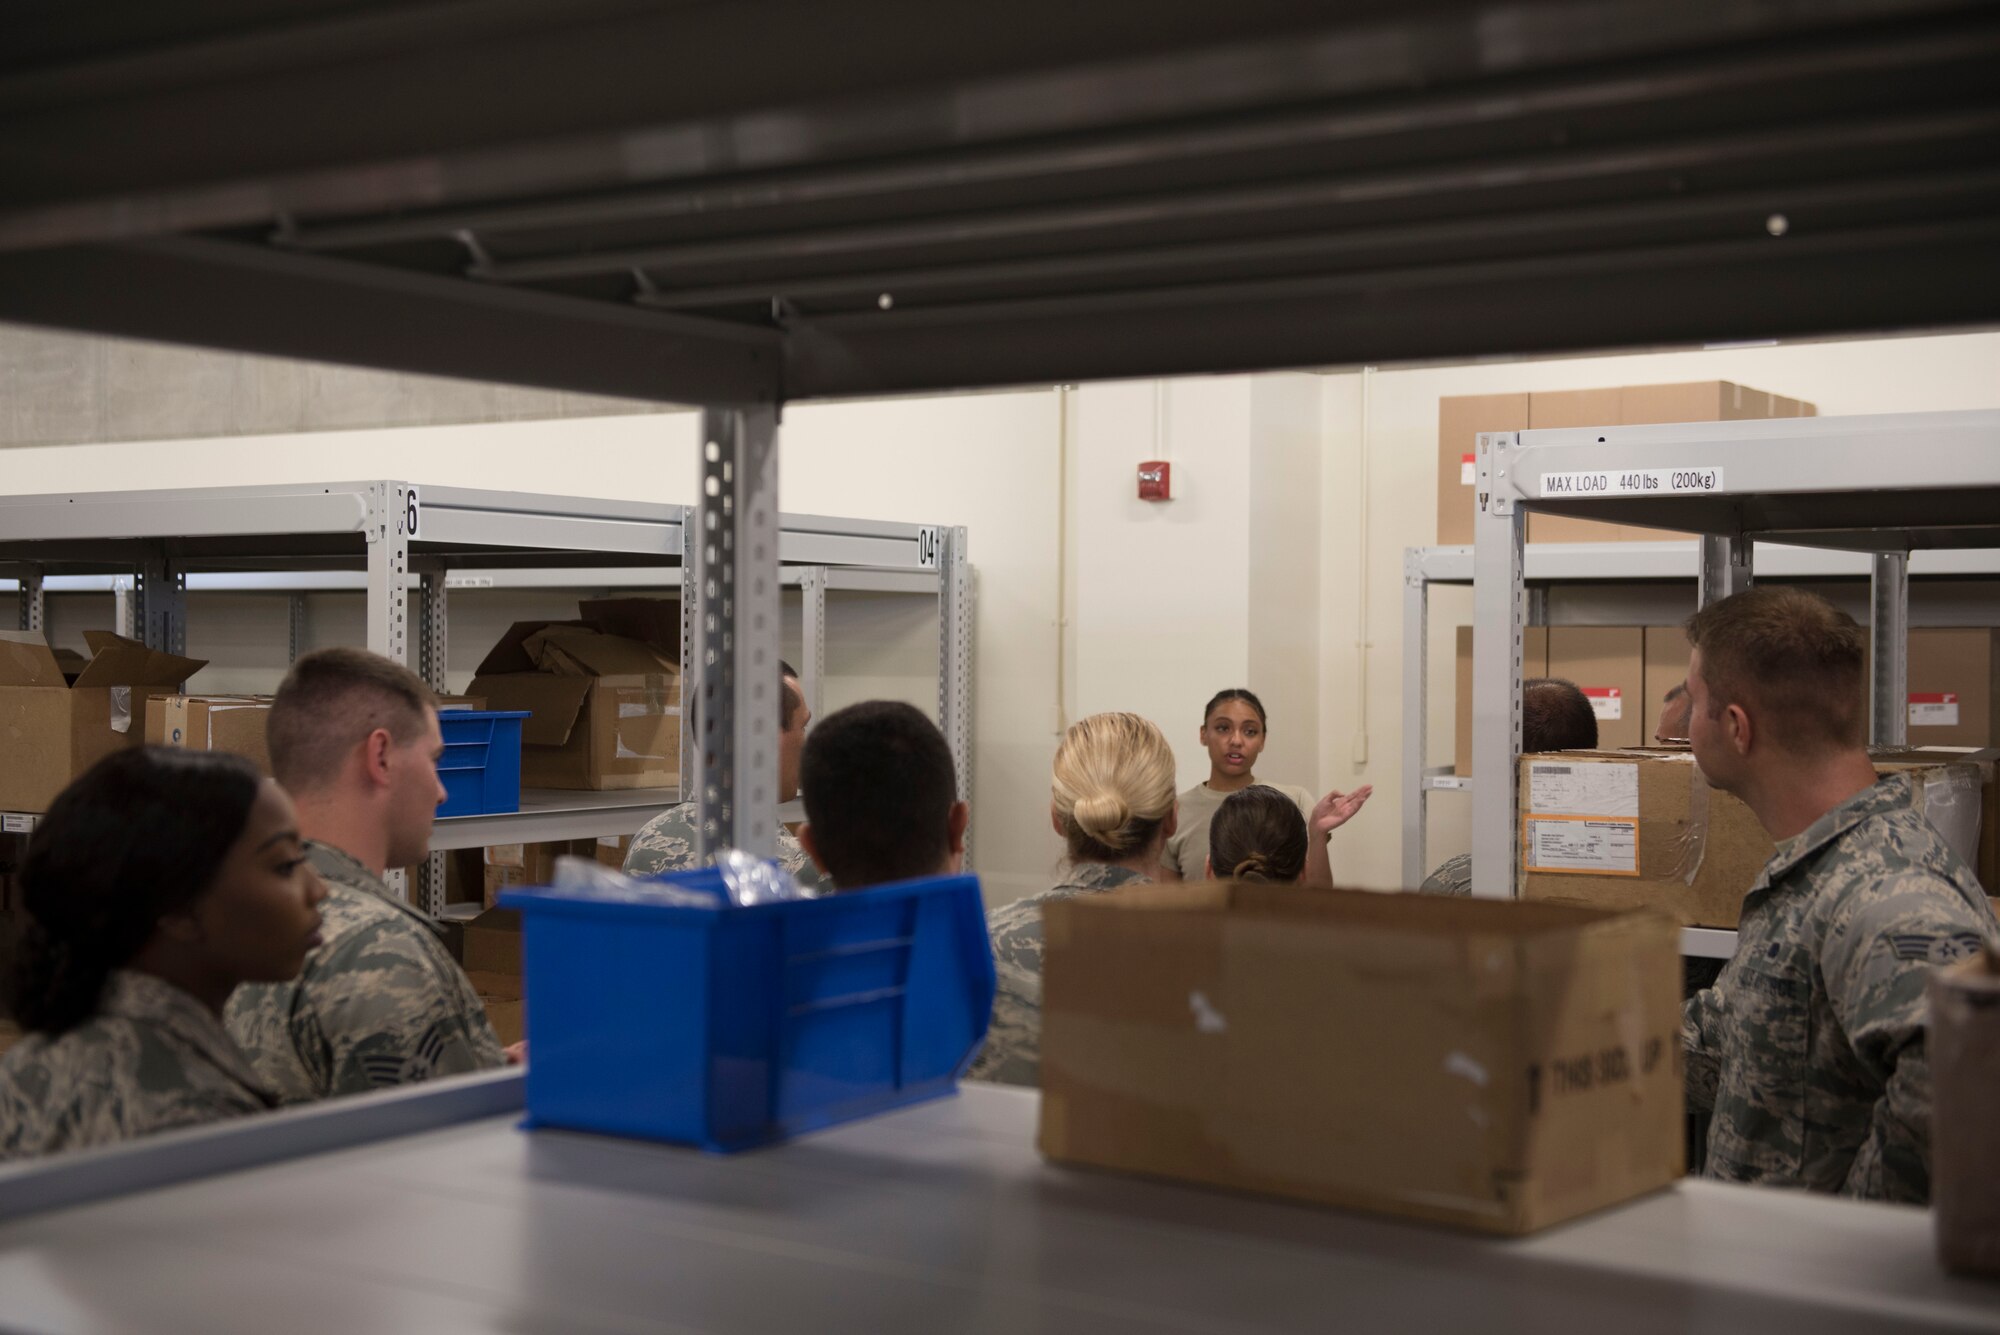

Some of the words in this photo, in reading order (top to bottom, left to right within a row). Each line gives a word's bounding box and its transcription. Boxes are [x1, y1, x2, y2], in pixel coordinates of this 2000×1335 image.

[1546, 476, 1572, 493] MAX
[1576, 475, 1607, 491] LOAD
[1671, 471, 1716, 490] (200kg)
[920, 529, 934, 565] 04
